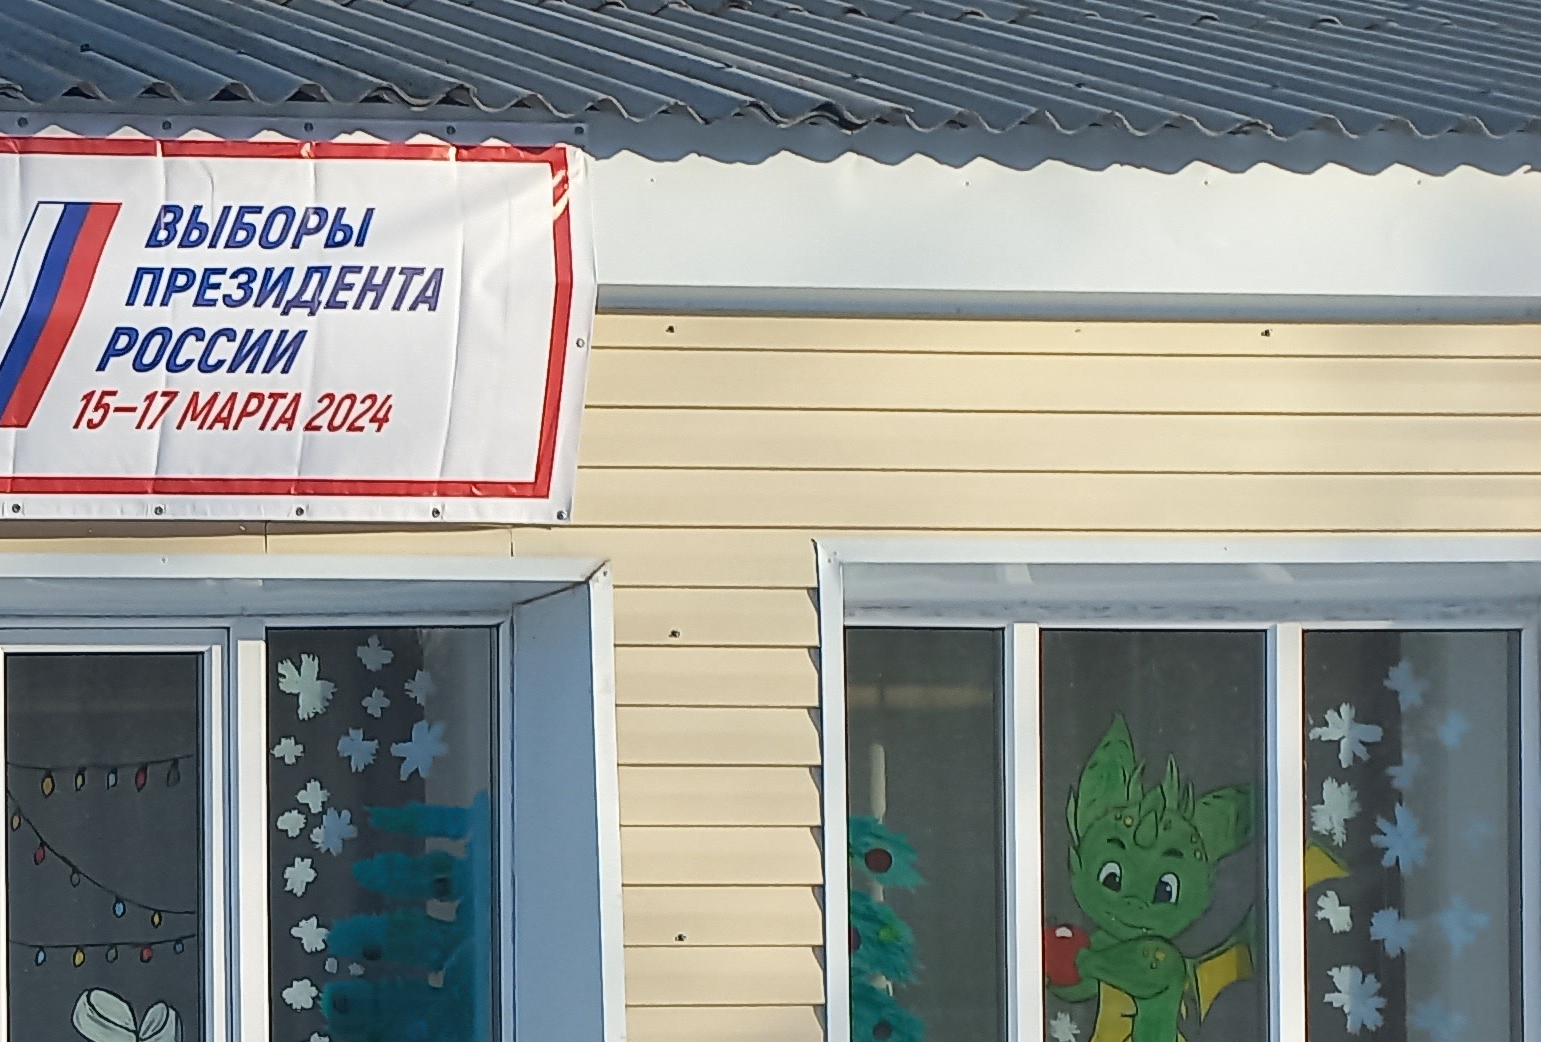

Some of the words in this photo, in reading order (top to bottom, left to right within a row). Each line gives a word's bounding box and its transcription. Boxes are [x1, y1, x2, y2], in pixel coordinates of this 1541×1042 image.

[145, 204, 375, 249] ВЫБОРЫ
[125, 267, 444, 316] ПРЕЗИДЕНТА
[96, 327, 307, 374] РОССИИ
[177, 392, 300, 432] МАРТА
[304, 394, 392, 433] 2024
